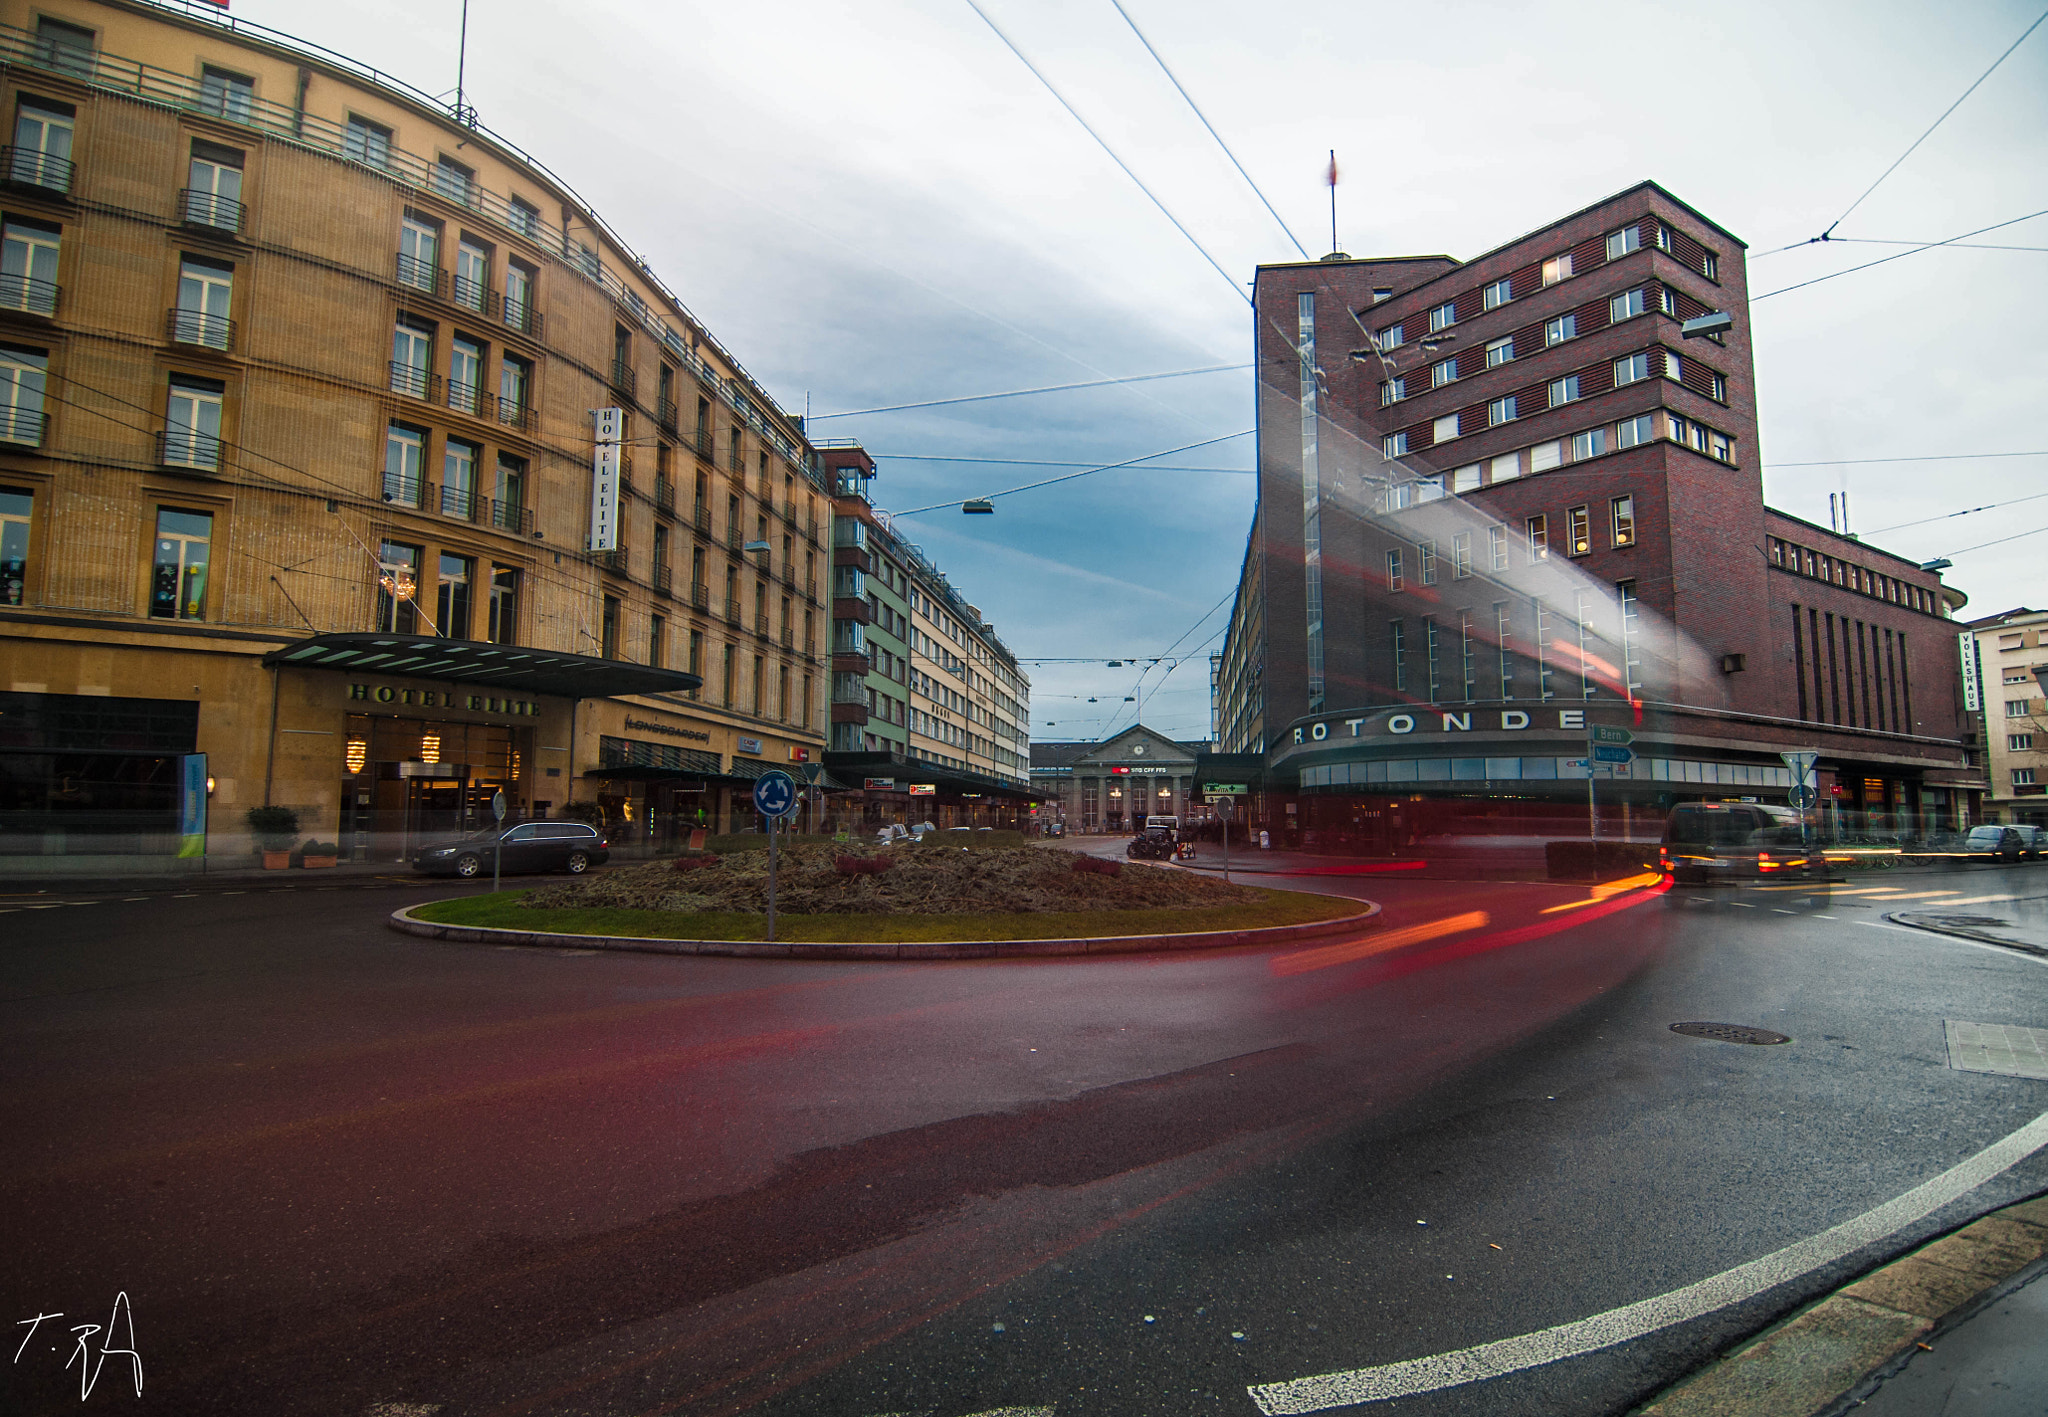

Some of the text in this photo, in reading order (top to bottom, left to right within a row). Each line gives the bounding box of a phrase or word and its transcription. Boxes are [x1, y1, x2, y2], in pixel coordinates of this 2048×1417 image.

[598, 410, 613, 549] HOTEL ELITE
[1962, 635, 1975, 708] VOLKSHAUS
[349, 683, 541, 717] HOTEL ELITE
[1293, 709, 1586, 745] ROTONDE
[1600, 728, 1622, 740] Bern
